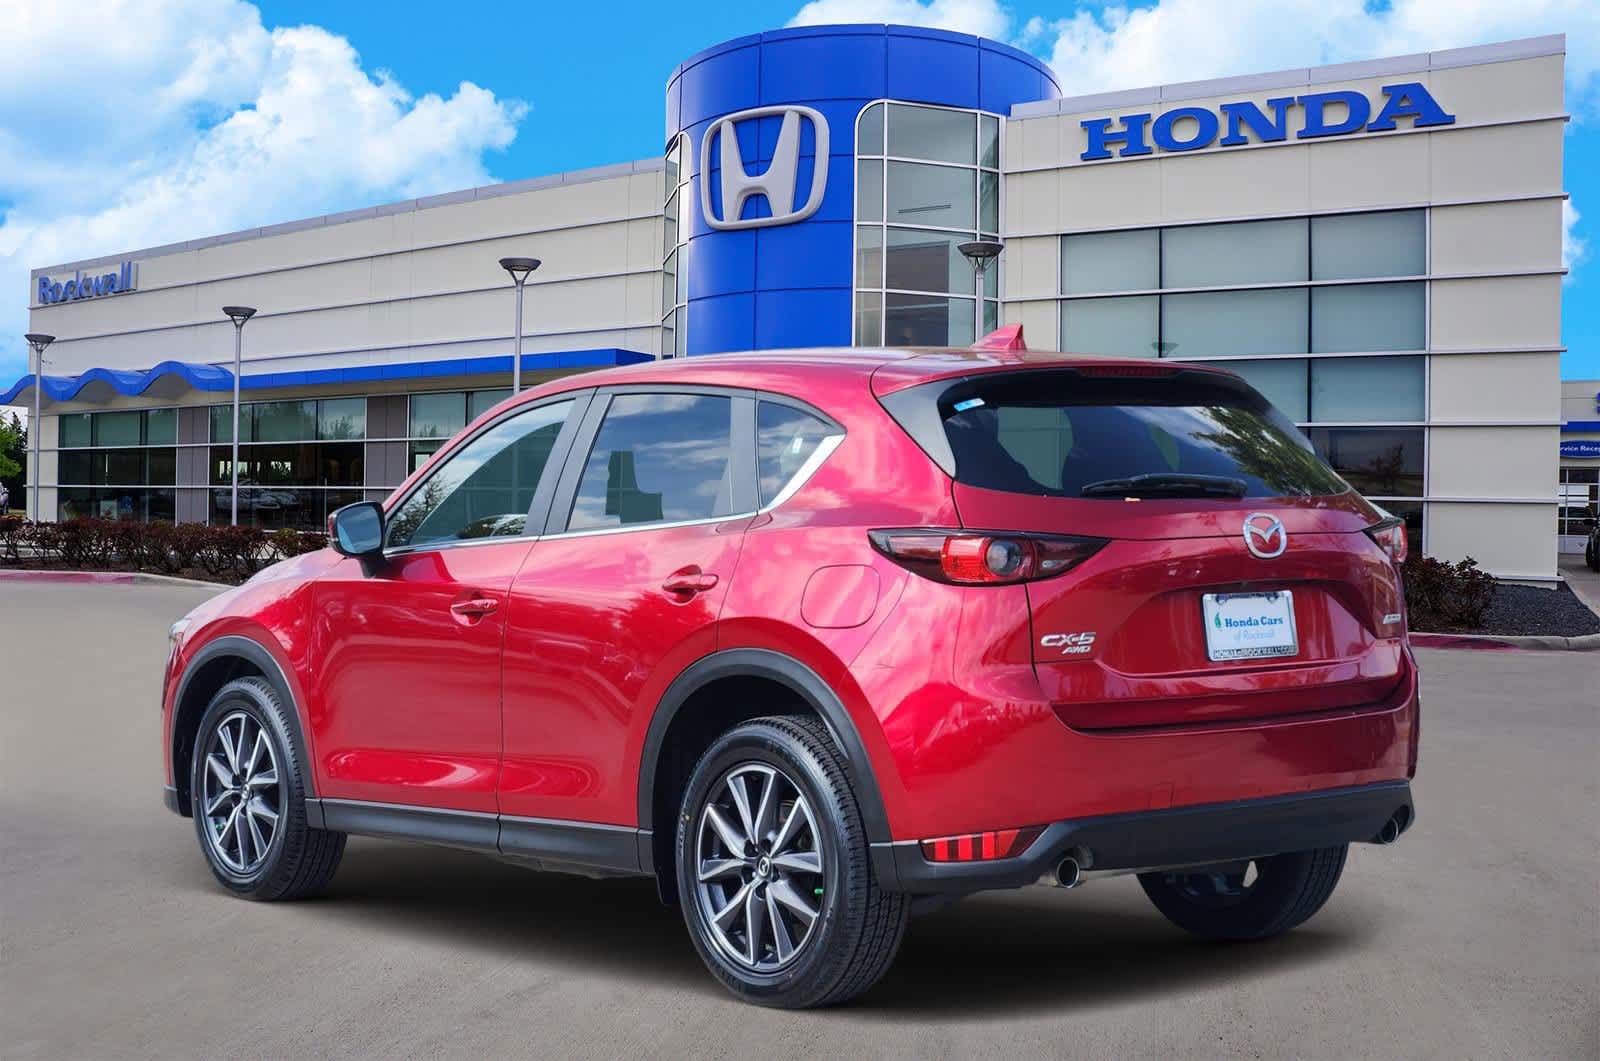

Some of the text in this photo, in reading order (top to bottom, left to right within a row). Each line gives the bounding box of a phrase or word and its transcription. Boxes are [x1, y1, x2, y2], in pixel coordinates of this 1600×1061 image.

[1080, 82, 1456, 161] HONDA
[38, 260, 134, 304] Rockwall
[1224, 616, 1284, 627] Honda Cars
[1040, 632, 1096, 646] CX-5
